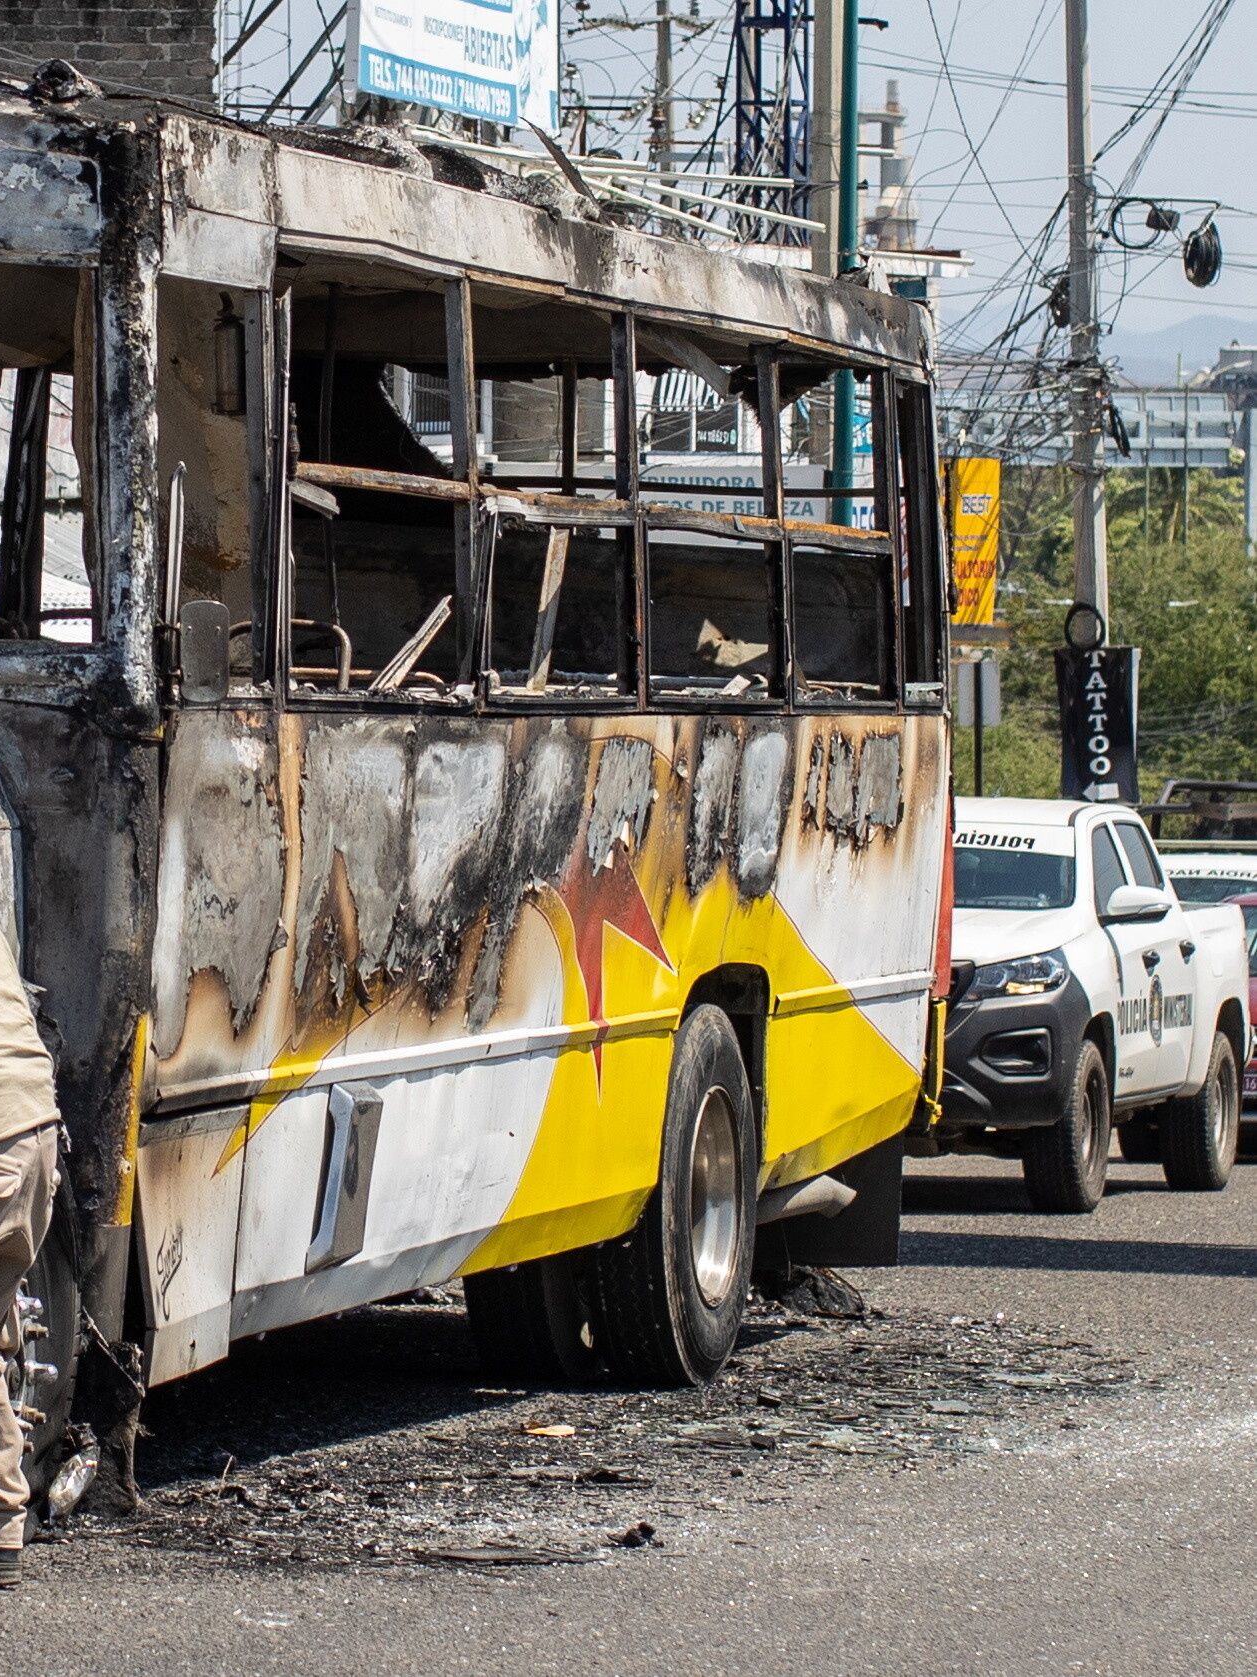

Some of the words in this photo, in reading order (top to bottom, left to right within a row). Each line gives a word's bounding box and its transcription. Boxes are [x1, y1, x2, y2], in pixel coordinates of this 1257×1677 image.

[463, 26, 512, 71] ABIERTAS
[701, 501, 725, 514] DE
[733, 501, 814, 517] BELEZA
[1084, 650, 1112, 776] TATTOO
